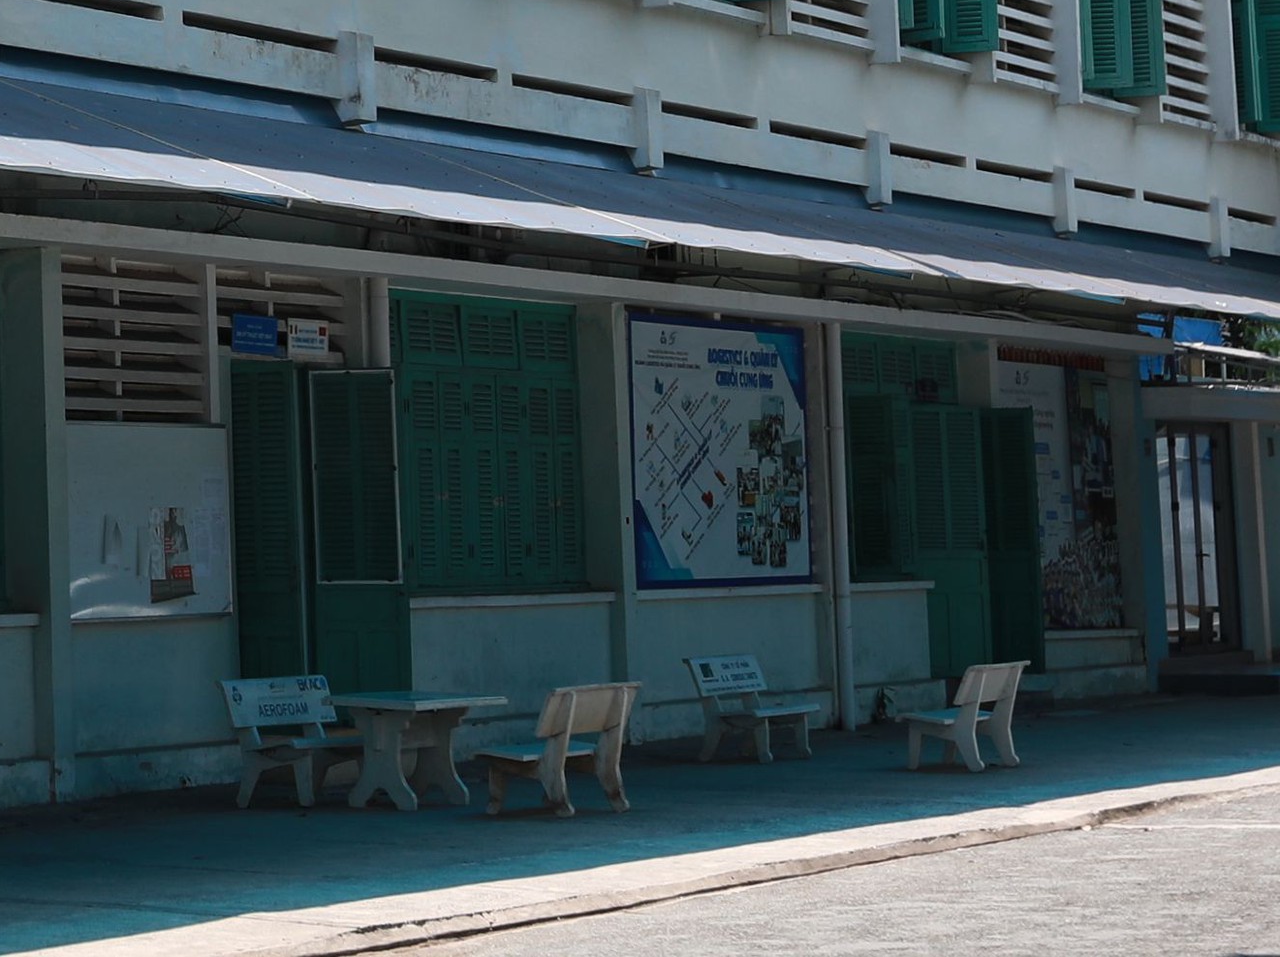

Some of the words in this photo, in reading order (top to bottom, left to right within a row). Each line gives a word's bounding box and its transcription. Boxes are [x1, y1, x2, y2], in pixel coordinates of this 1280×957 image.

[707, 347, 743, 365] LOGISTICS
[739, 372, 758, 388] CUNG
[258, 702, 309, 717] AEROFOAM
